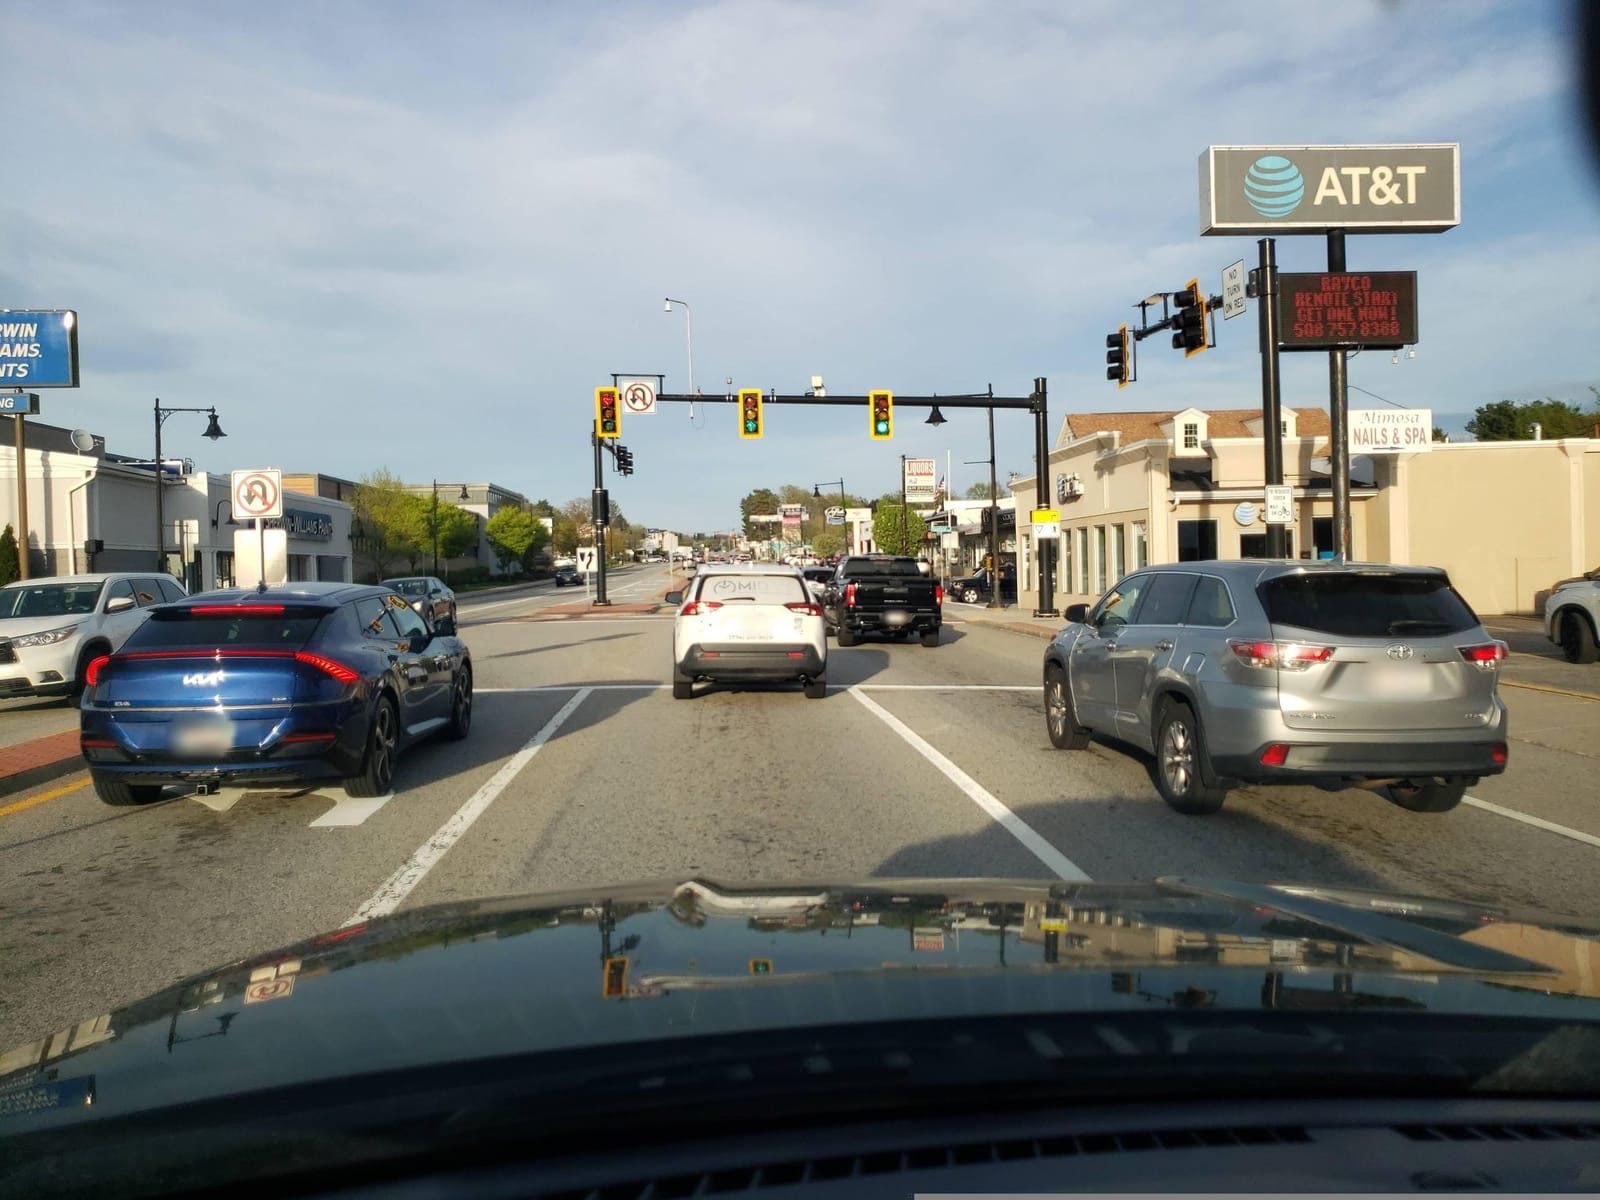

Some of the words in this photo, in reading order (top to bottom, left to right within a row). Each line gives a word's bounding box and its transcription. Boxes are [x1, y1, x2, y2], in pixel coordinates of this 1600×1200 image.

[1313, 166, 1427, 206] AT&T
[1228, 269, 1237, 281] NO
[1227, 284, 1240, 297] TURN
[1320, 276, 1371, 292] RAYCO
[1225, 303, 1233, 314] ON
[1234, 296, 1244, 308] RED
[1295, 292, 1350, 307] REMOTE
[1295, 322, 1323, 337] 508
[1360, 411, 1419, 424] Mimosa
[1353, 427, 1388, 445] NAILS
[1392, 427, 1401, 445] &
[1404, 427, 1427, 445] SPA
[907, 461, 934, 475] LIQUORS
